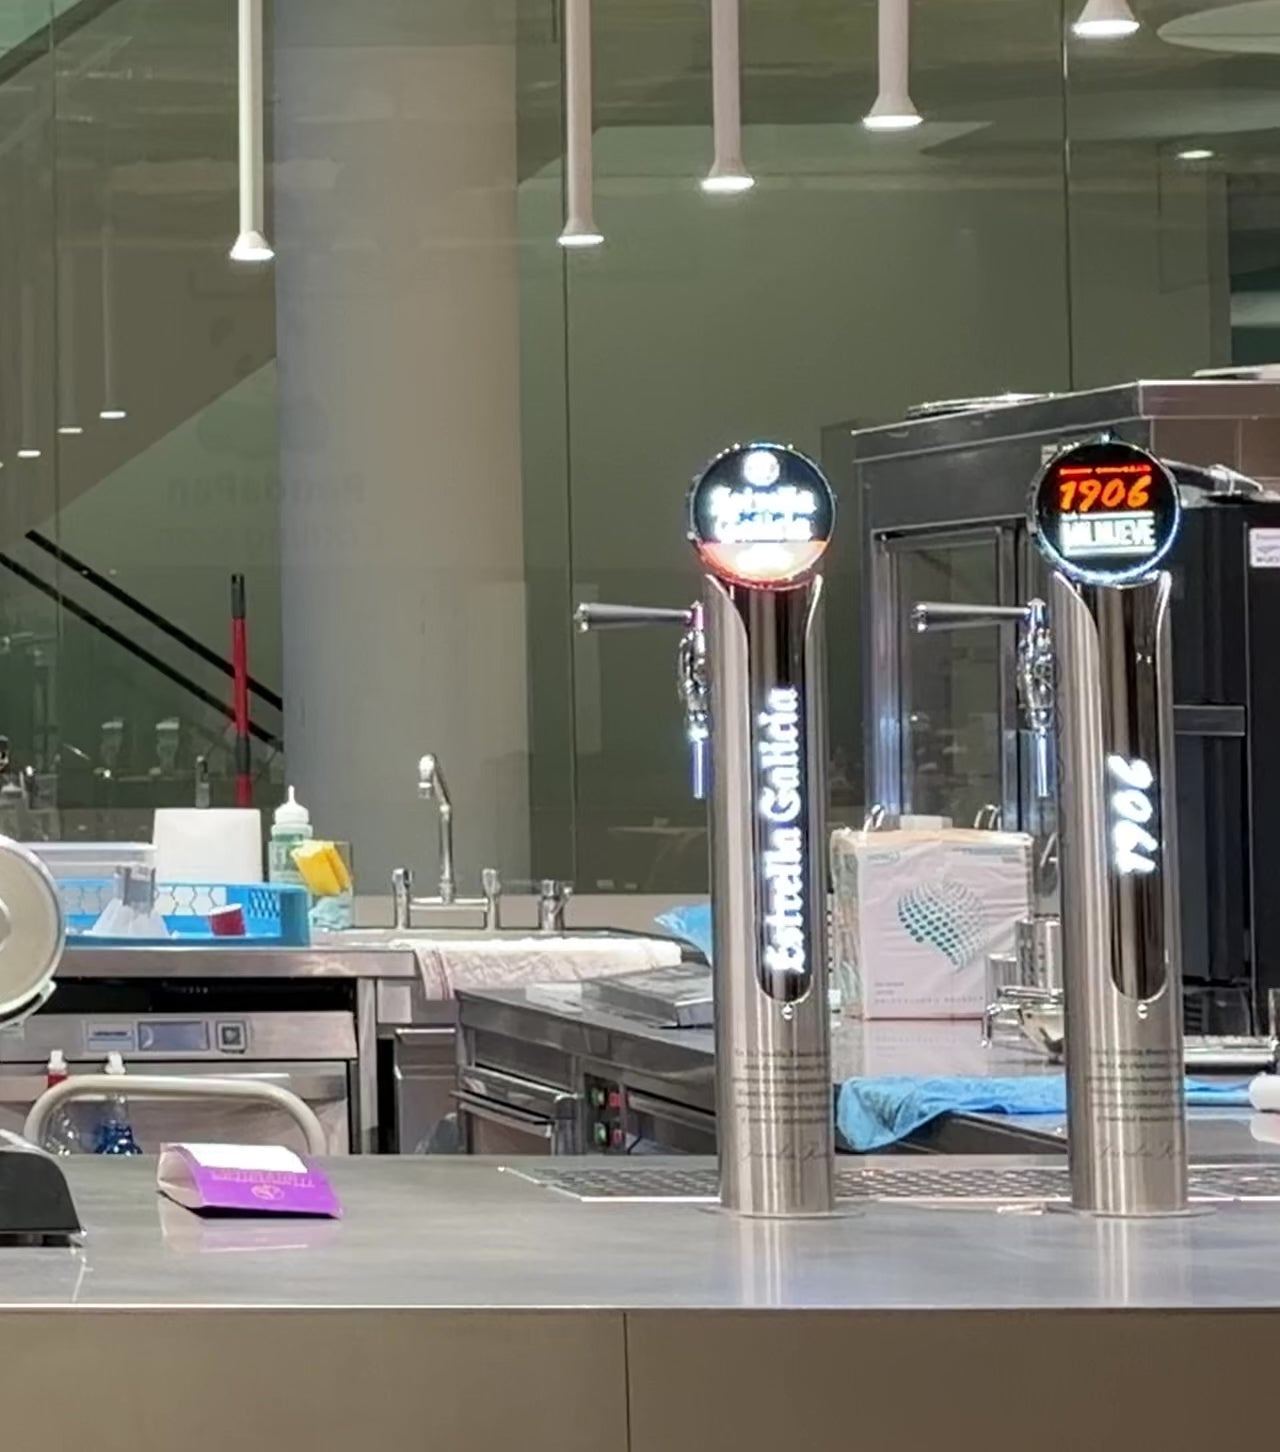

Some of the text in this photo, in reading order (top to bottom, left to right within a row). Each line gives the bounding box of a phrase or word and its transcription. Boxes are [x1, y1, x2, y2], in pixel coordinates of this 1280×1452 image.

[1060, 475, 1152, 512] 1906
[758, 686, 806, 973] Estrella Galicia
[1106, 753, 1156, 876] 1906
